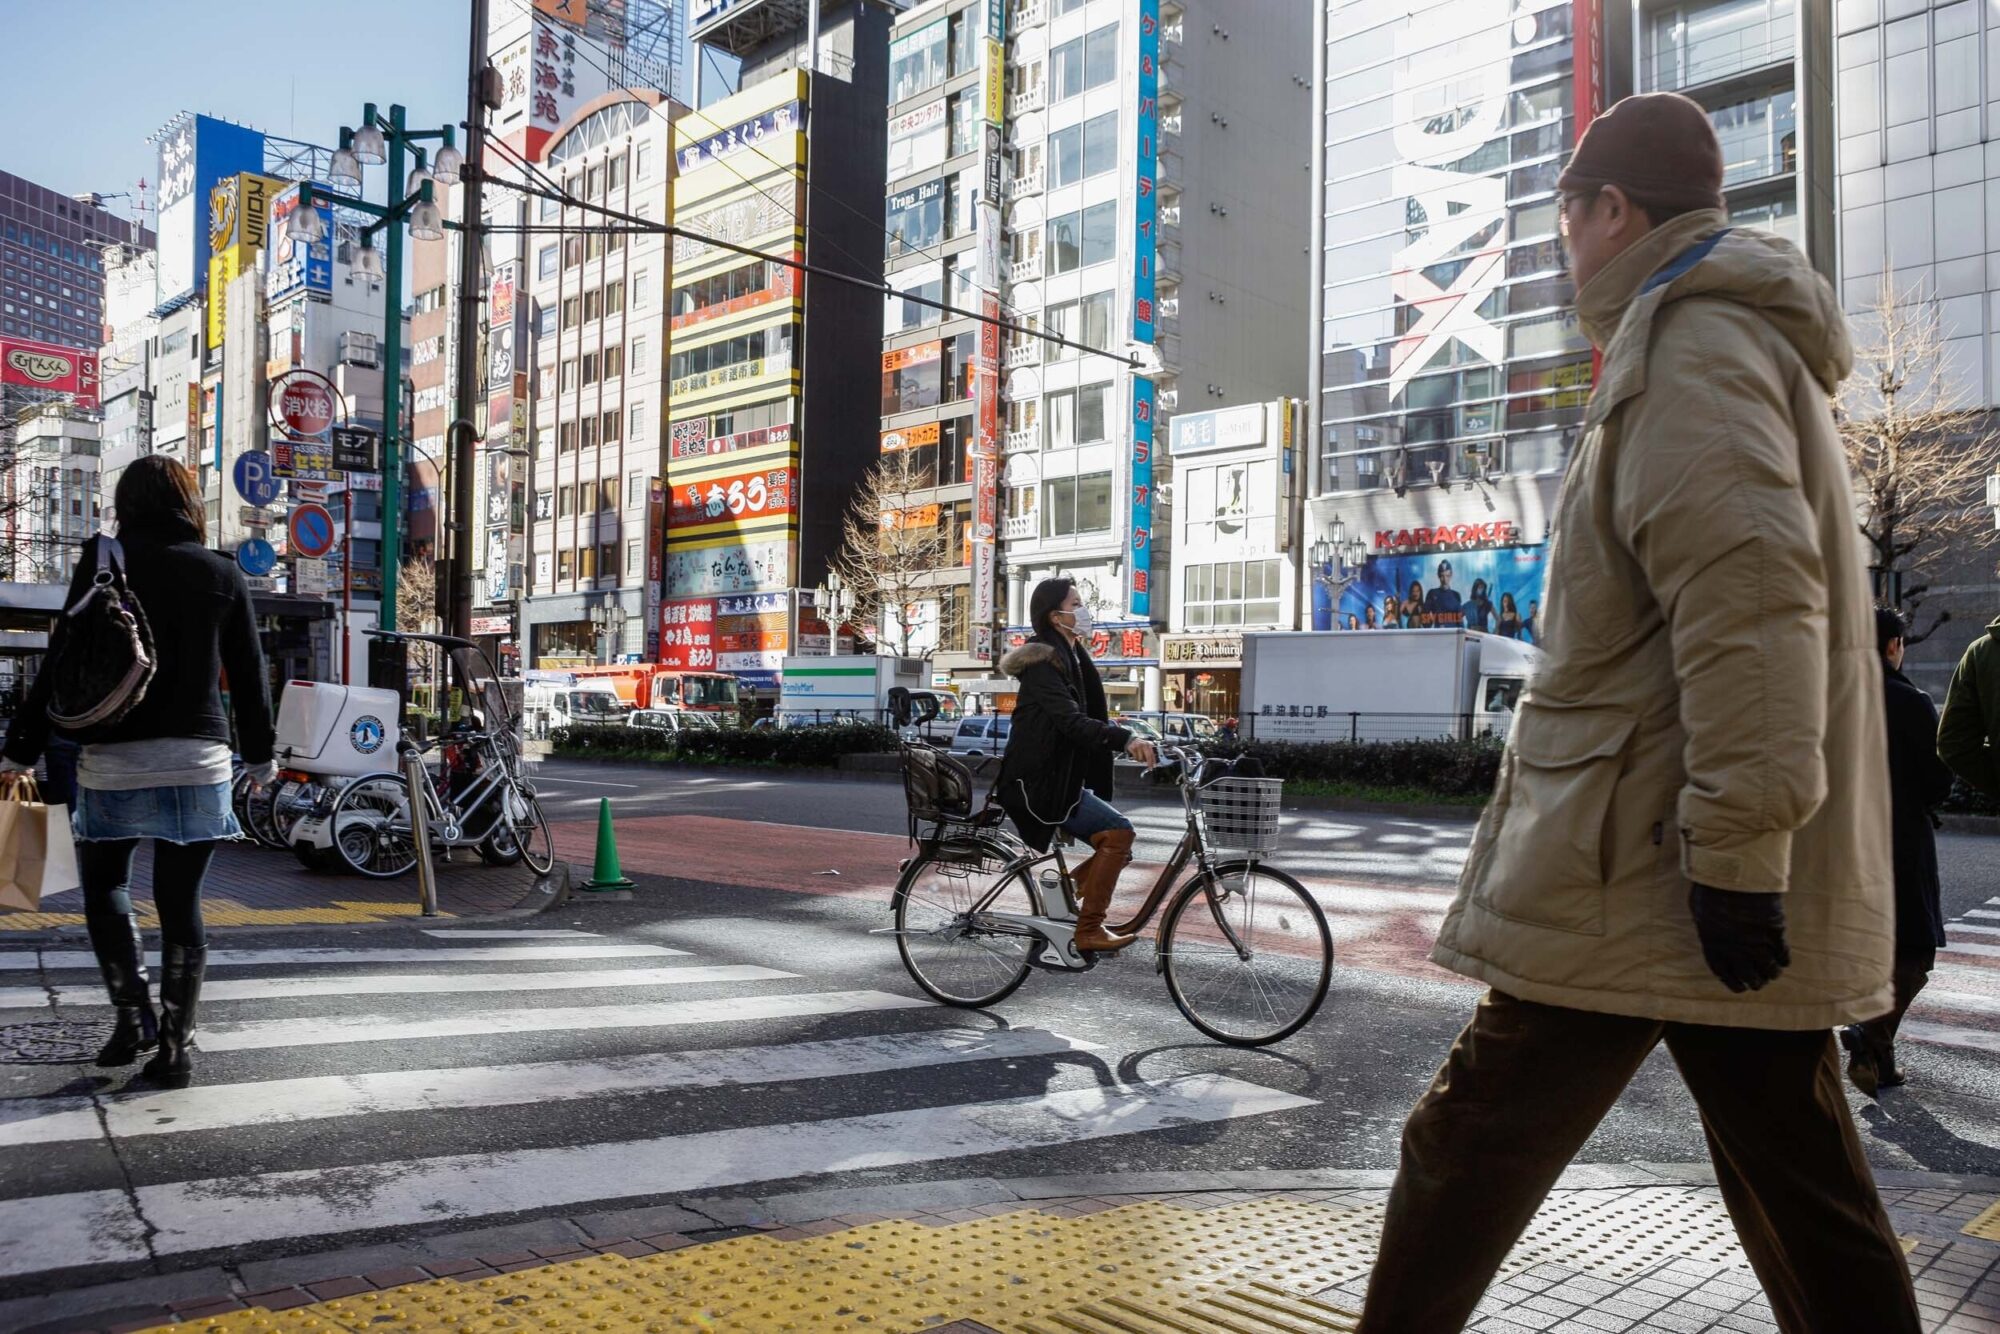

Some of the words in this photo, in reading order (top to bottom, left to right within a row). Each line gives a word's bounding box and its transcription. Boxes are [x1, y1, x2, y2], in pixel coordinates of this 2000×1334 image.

[900, 105, 944, 130] 中央コンタクト
[710, 120, 764, 155] かまくら
[891, 191, 914, 210] Trans
[919, 183, 939, 200] Hair
[14, 353, 67, 378] むじんくん
[285, 396, 330, 419] 消火栓
[338, 433, 368, 449] モア
[1179, 421, 1210, 444] 脱毛
[244, 462, 263, 495] P
[257, 483, 271, 498] 40
[1133, 400, 1150, 593] カラオケ館
[1375, 520, 1513, 549] KARAOKE
[735, 596, 768, 612] かまくら
